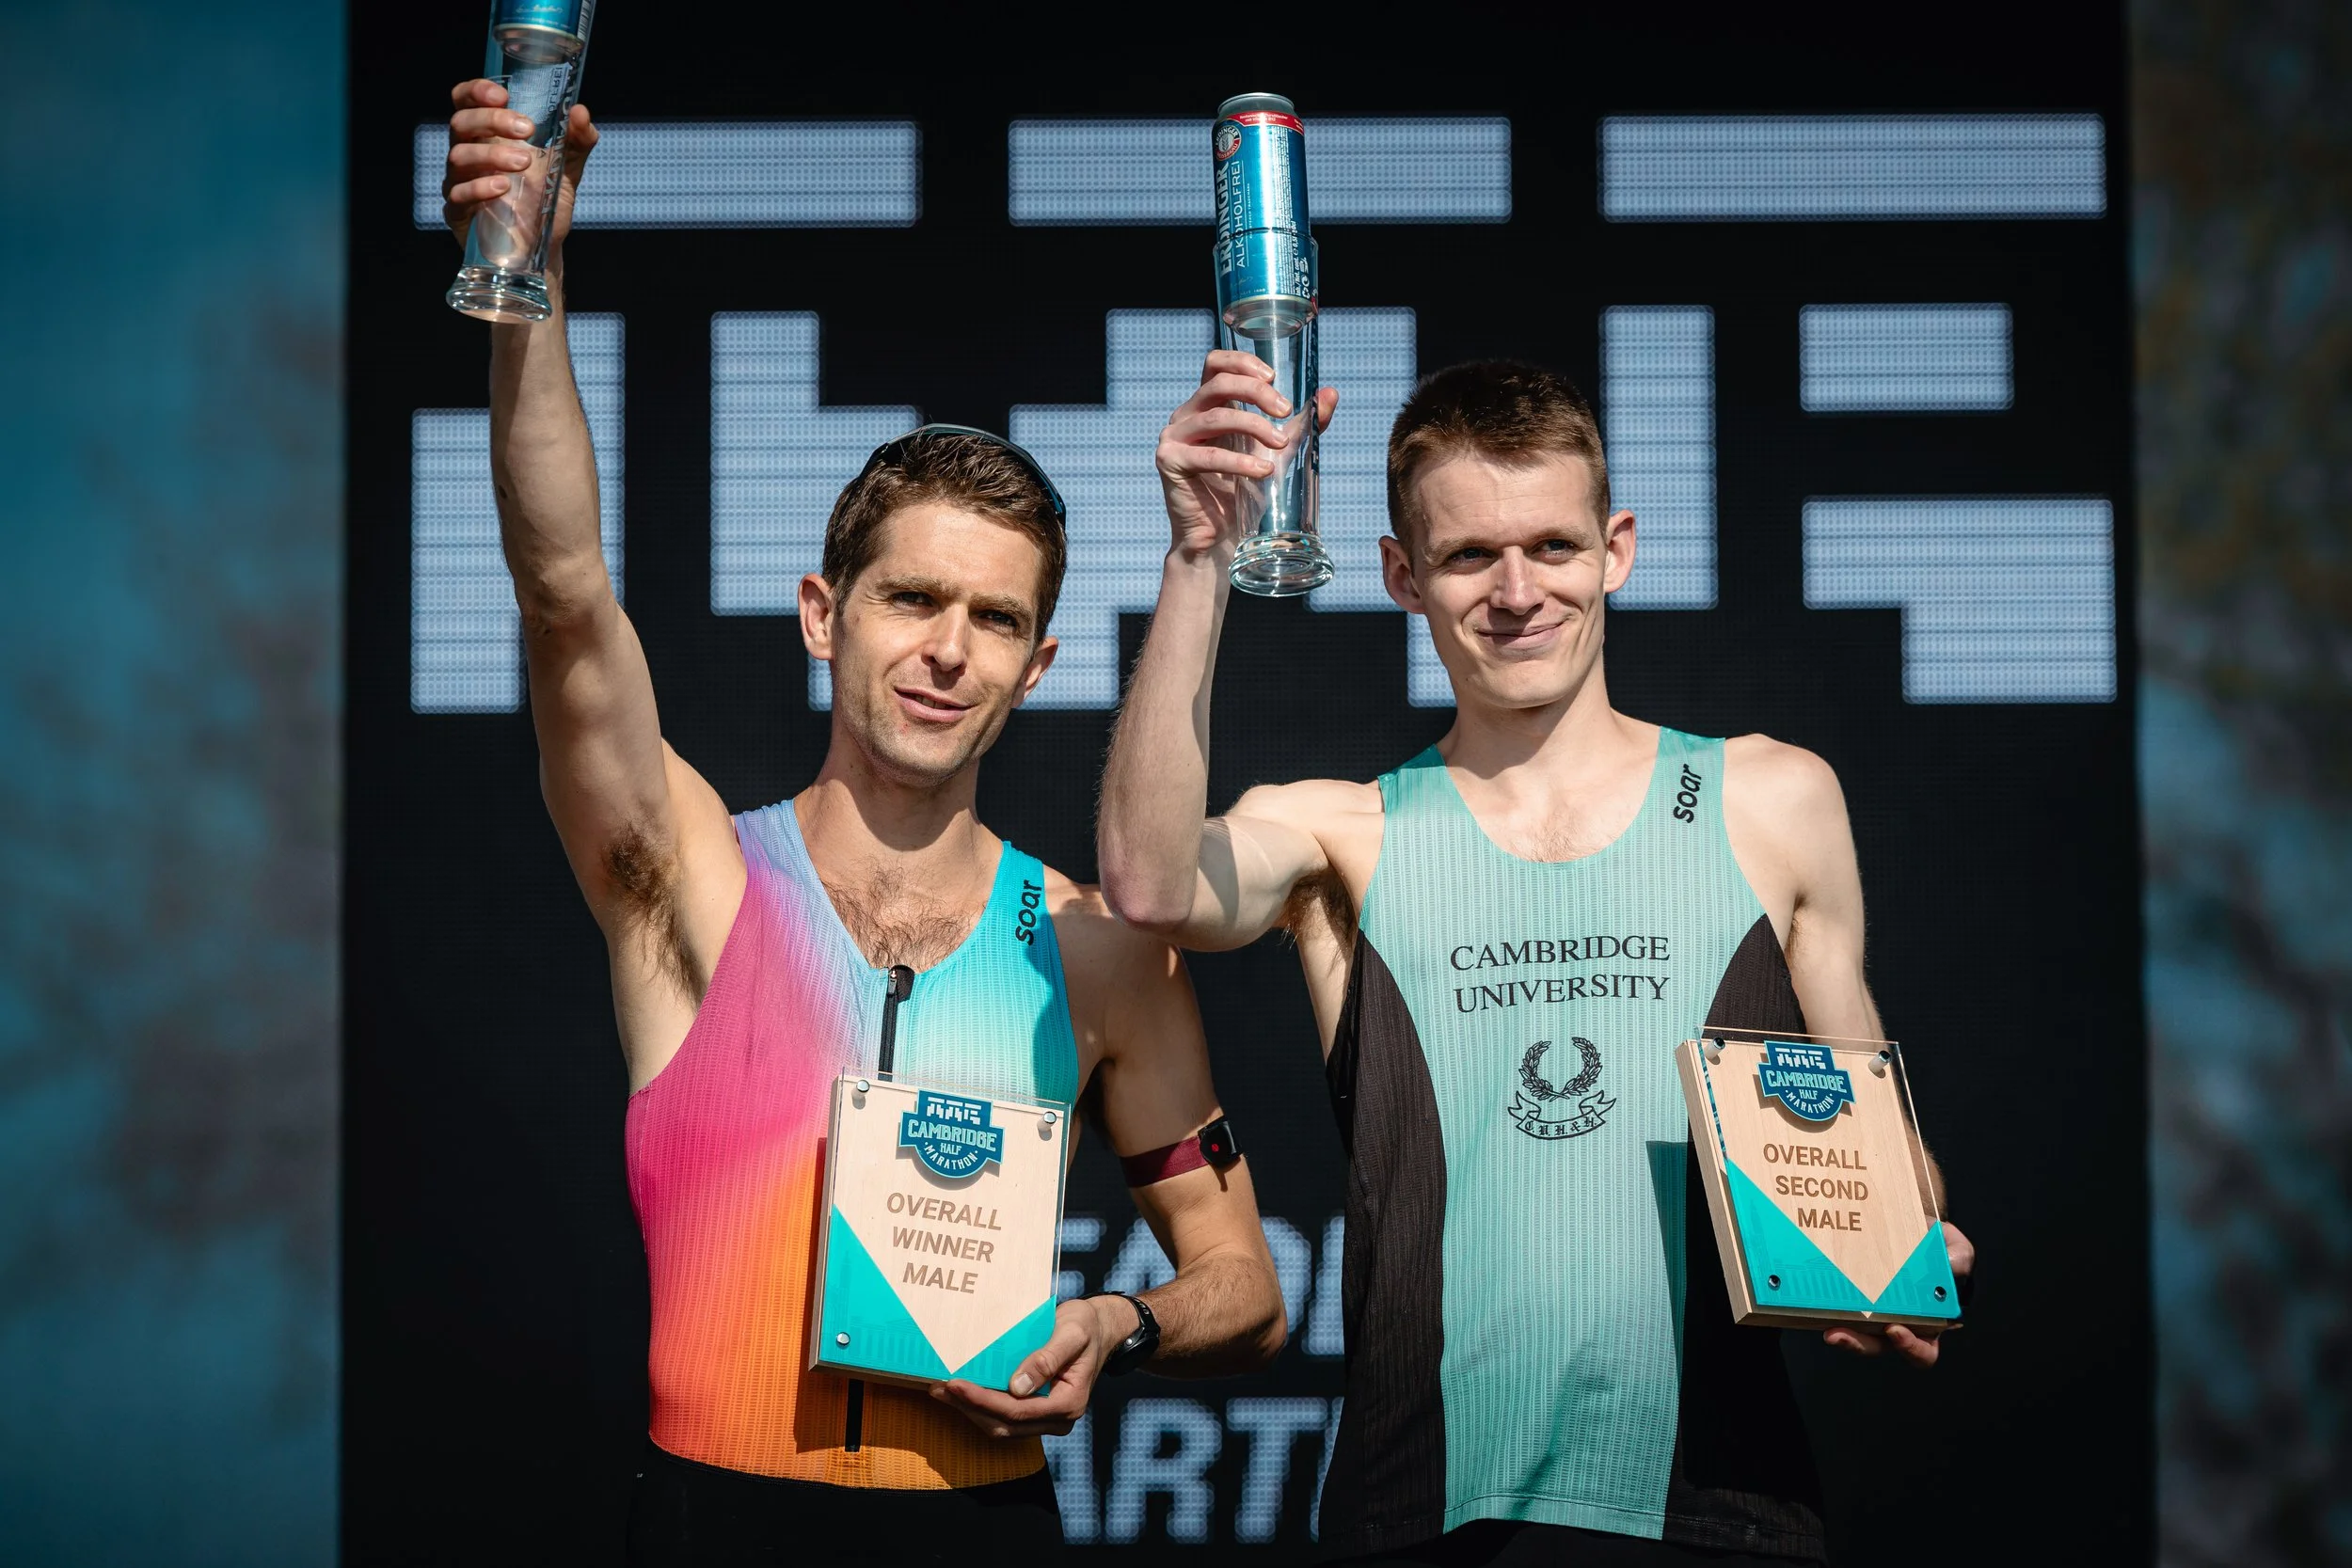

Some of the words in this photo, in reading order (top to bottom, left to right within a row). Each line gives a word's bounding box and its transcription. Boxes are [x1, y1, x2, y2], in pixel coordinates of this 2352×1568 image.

[1216, 162, 1232, 277] ERDINGER
[1231, 161, 1246, 268] ALKOHOLFREI
[1674, 764, 1702, 823] soar
[1015, 879, 1041, 946] soar
[1450, 935, 1671, 971] CAMBRIDGE
[1453, 974, 1671, 1013] UNIVERSITY
[1766, 1069, 1847, 1093] CAMBRIDGE
[1799, 1089, 1818, 1100] HALF
[1786, 1091, 1835, 1114] MARATHON
[908, 1118, 997, 1152] CAMBRIDGE
[941, 1143, 961, 1155] HALF
[924, 1144, 978, 1170] MARATHON
[1763, 1143, 1867, 1171] OVERALL
[1774, 1175, 1868, 1201] SECOND
[886, 1192, 1002, 1231] OVERALL
[1797, 1207, 1863, 1232] MALE
[892, 1226, 995, 1263] WINNER
[902, 1262, 978, 1294] MALE
